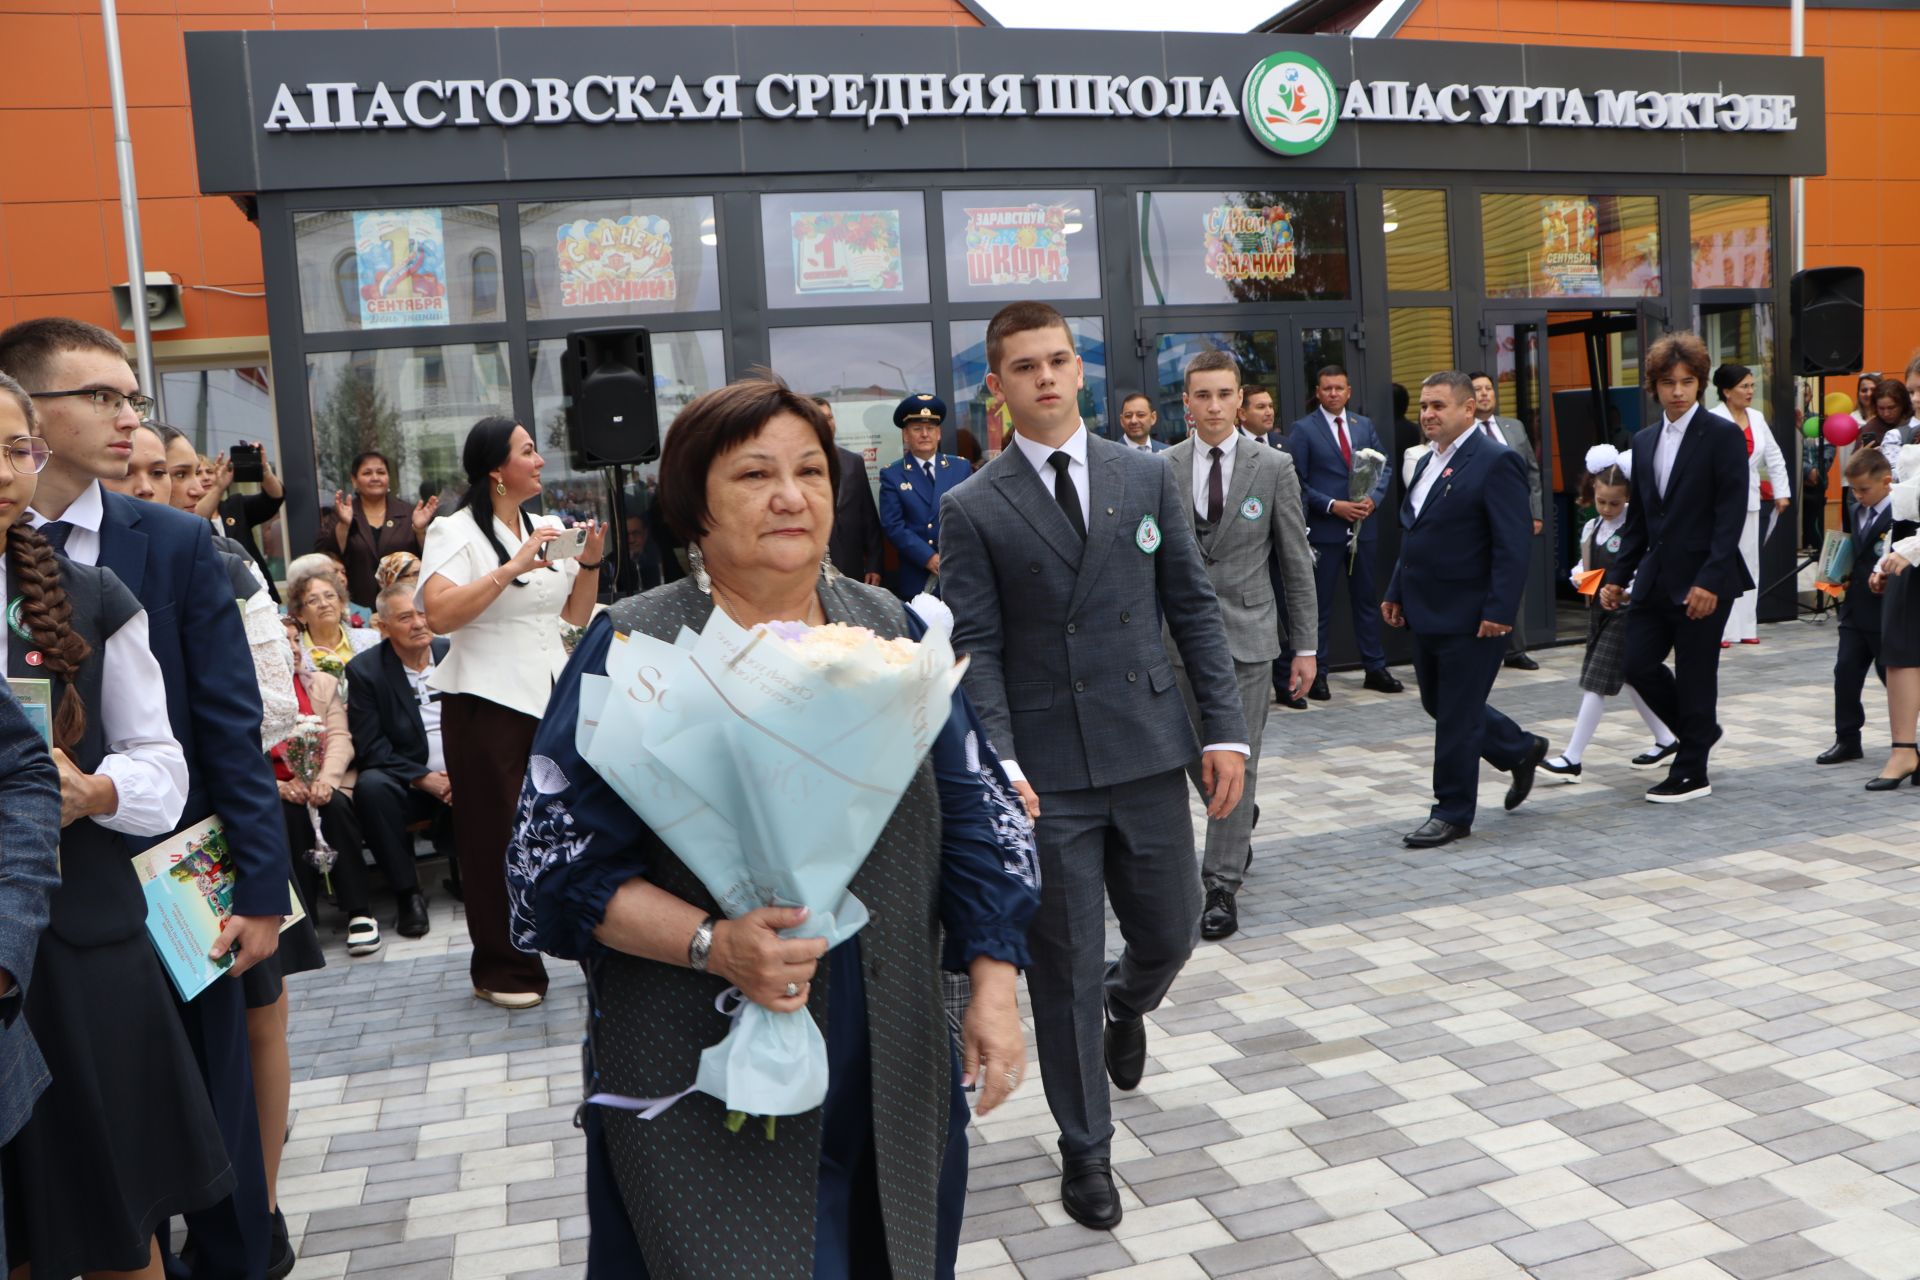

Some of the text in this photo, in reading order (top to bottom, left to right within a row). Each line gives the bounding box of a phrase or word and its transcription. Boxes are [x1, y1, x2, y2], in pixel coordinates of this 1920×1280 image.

[264, 73, 1239, 131] АПАСТОВСКАЯ СРЕДНЯЯ ШКОЛА
[1340, 80, 1798, 131] АПАС УРТА МӘКТӘБЕ
[567, 226, 663, 262] С ДНЕМ
[1563, 207, 1578, 251] 1
[814, 231, 835, 269] 1
[968, 243, 1061, 284] ШКОЛА
[1216, 249, 1294, 274] ЗНАНИЙ!
[1547, 252, 1591, 264] СЕНТЯБРЯ
[367, 297, 443, 313] СЕНТЯБРЯ
